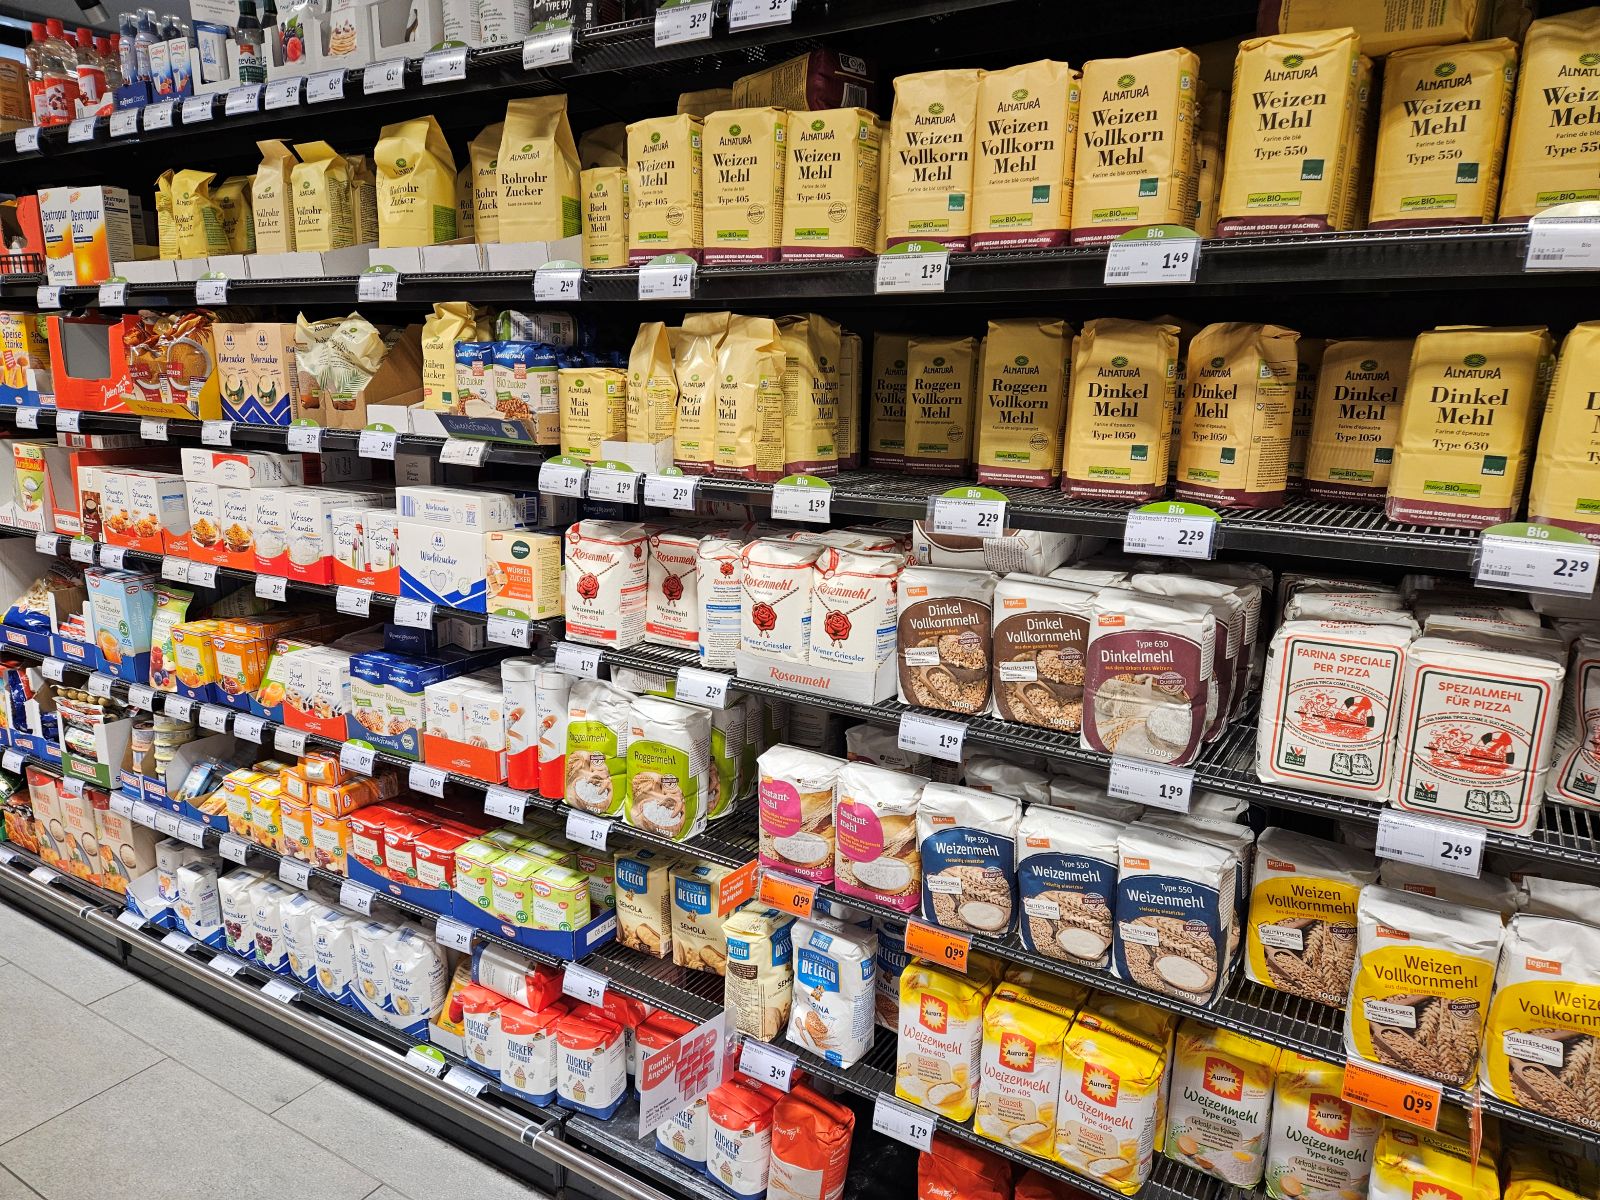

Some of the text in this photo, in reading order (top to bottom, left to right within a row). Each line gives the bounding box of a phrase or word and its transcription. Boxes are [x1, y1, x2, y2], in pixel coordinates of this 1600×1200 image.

[689, 14, 707, 30] 3.29
[1264, 65, 1318, 82] ALNATURA
[329, 78, 341, 89] 6.49
[998, 98, 1040, 112] ALNATURA
[1252, 91, 1327, 109] Weizen
[914, 113, 956, 125] ALNATURA
[1258, 110, 1312, 131] Mehl
[988, 120, 1049, 136] Weizen
[800, 130, 835, 142] ALNATURA
[905, 132, 964, 147] Weizen
[981, 138, 1054, 156] Vollkorn
[1254, 144, 1308, 159] Type 550
[509, 151, 540, 162] ALNATURA
[793, 150, 841, 163] Weizen
[899, 149, 968, 166] Vollkorn
[993, 155, 1036, 174] Mehl
[501, 172, 548, 185] Rohrohr
[798, 164, 833, 180] Mehl
[911, 165, 952, 183] Mehl
[505, 185, 544, 198] Zucker
[796, 192, 831, 202] Type 405
[590, 203, 607, 212] Buch
[42, 209, 67, 221] Dextropur
[588, 213, 610, 223] Weizen
[43, 223, 54, 234] plus
[590, 223, 607, 232] Mehl
[1147, 229, 1164, 238] Bio
[907, 244, 921, 252] Bio
[1162, 253, 1188, 270] 1.49
[921, 264, 942, 279] 1.39
[381, 281, 393, 292] 2.99
[561, 281, 573, 292] 2.49
[672, 274, 688, 288] 1.49
[2, 329, 23, 339] Speise-
[5, 340, 23, 349] stärke
[1002, 365, 1039, 375] ALNATURA
[1097, 366, 1141, 377] ALNATURA
[1444, 366, 1501, 379] ALNATURA
[915, 379, 961, 391] Roggen
[992, 379, 1047, 394] Roggen
[1088, 383, 1148, 399] Dinkel
[570, 397, 588, 407] Mais
[719, 395, 736, 408] Soja
[912, 394, 962, 405] Vollkorn
[989, 395, 1049, 409] Vollkorn
[1430, 386, 1509, 406] Dinkel
[569, 407, 588, 417] Mehl
[718, 408, 737, 420] Mehl
[920, 407, 950, 419] Mehl
[1093, 402, 1138, 418] Mehl
[1437, 407, 1494, 426] Mehl
[1000, 410, 1034, 424] Mehl
[1091, 430, 1136, 440] Type 1050
[1454, 429, 1490, 438] d'épeautre
[1432, 439, 1489, 451] Type 630
[617, 483, 630, 494] 1.99
[673, 488, 688, 500] 2.29
[967, 490, 981, 498] Bio
[257, 504, 278, 517] Weisser
[808, 499, 825, 512] 1.59
[1168, 505, 1185, 515] Bio
[226, 510, 246, 521] Kandis
[290, 511, 313, 522] Weisser
[977, 513, 999, 527] 2.29
[291, 521, 314, 533] Kandis
[1527, 527, 1549, 539] Bio
[1178, 530, 1204, 545] 2.29
[420, 551, 457, 565] Würfelzucker
[572, 548, 613, 564] Rosenmehl
[507, 566, 531, 576] WÜRFEL
[1553, 559, 1589, 577] 2.29
[509, 575, 531, 583] ZUCKER
[743, 574, 792, 591] Rosenmehl
[416, 610, 427, 621] 1.79
[571, 604, 605, 616] Weizenmehl
[928, 604, 962, 616] Dinkel
[910, 614, 980, 630] Vollkornmehl
[1027, 617, 1063, 630] Dinkel
[511, 627, 524, 638] 4.99
[1006, 629, 1082, 644] Vollkornmehl
[1136, 640, 1152, 649] Type
[812, 645, 865, 662] Wiener Griessler
[1101, 650, 1174, 664] Dinkelmehl
[1297, 648, 1391, 668] FARINA SPECIALE
[580, 660, 594, 672] 1.79
[1313, 662, 1371, 678] PER PIZZA
[289, 668, 303, 679] Hagel
[289, 677, 306, 688] Zucker
[706, 685, 721, 698] 2.29
[1438, 681, 1524, 702] SPEZIALMEHL
[1446, 694, 1512, 713] FÜR PIZZA
[1500, 723, 1525, 737] PIZZAIOLO!
[939, 734, 958, 748] 1.99
[634, 751, 676, 764] Roggenmehl
[761, 786, 790, 801] Instant-
[1159, 784, 1183, 799] 1.99
[761, 797, 777, 810] mehl
[1440, 842, 1472, 861] 2.49
[1032, 865, 1101, 882] Weizenmehl
[1160, 883, 1192, 894] Type 550
[792, 894, 809, 907] 0.99
[1127, 888, 1205, 908] Weizenmehl
[619, 900, 642, 913] SEMOLA
[945, 946, 964, 960] 0.99
[1404, 954, 1462, 975] Weizen
[1374, 965, 1478, 989] Vollkornmehl
[587, 986, 600, 998] 3.99
[507, 1040, 533, 1056] ZUCKER
[1507, 1035, 1561, 1054] QUALITÄTS-CHECK
[648, 1057, 671, 1072] Kombi-
[647, 1062, 674, 1081] Angebot
[770, 1065, 786, 1079] 3.49
[984, 1062, 1050, 1093] Weizenmehl
[1184, 1086, 1258, 1124] Weizenmehl
[1403, 1095, 1432, 1114] 0.99
[1202, 1108, 1237, 1127] Type 405
[910, 1124, 927, 1138] 1.79
